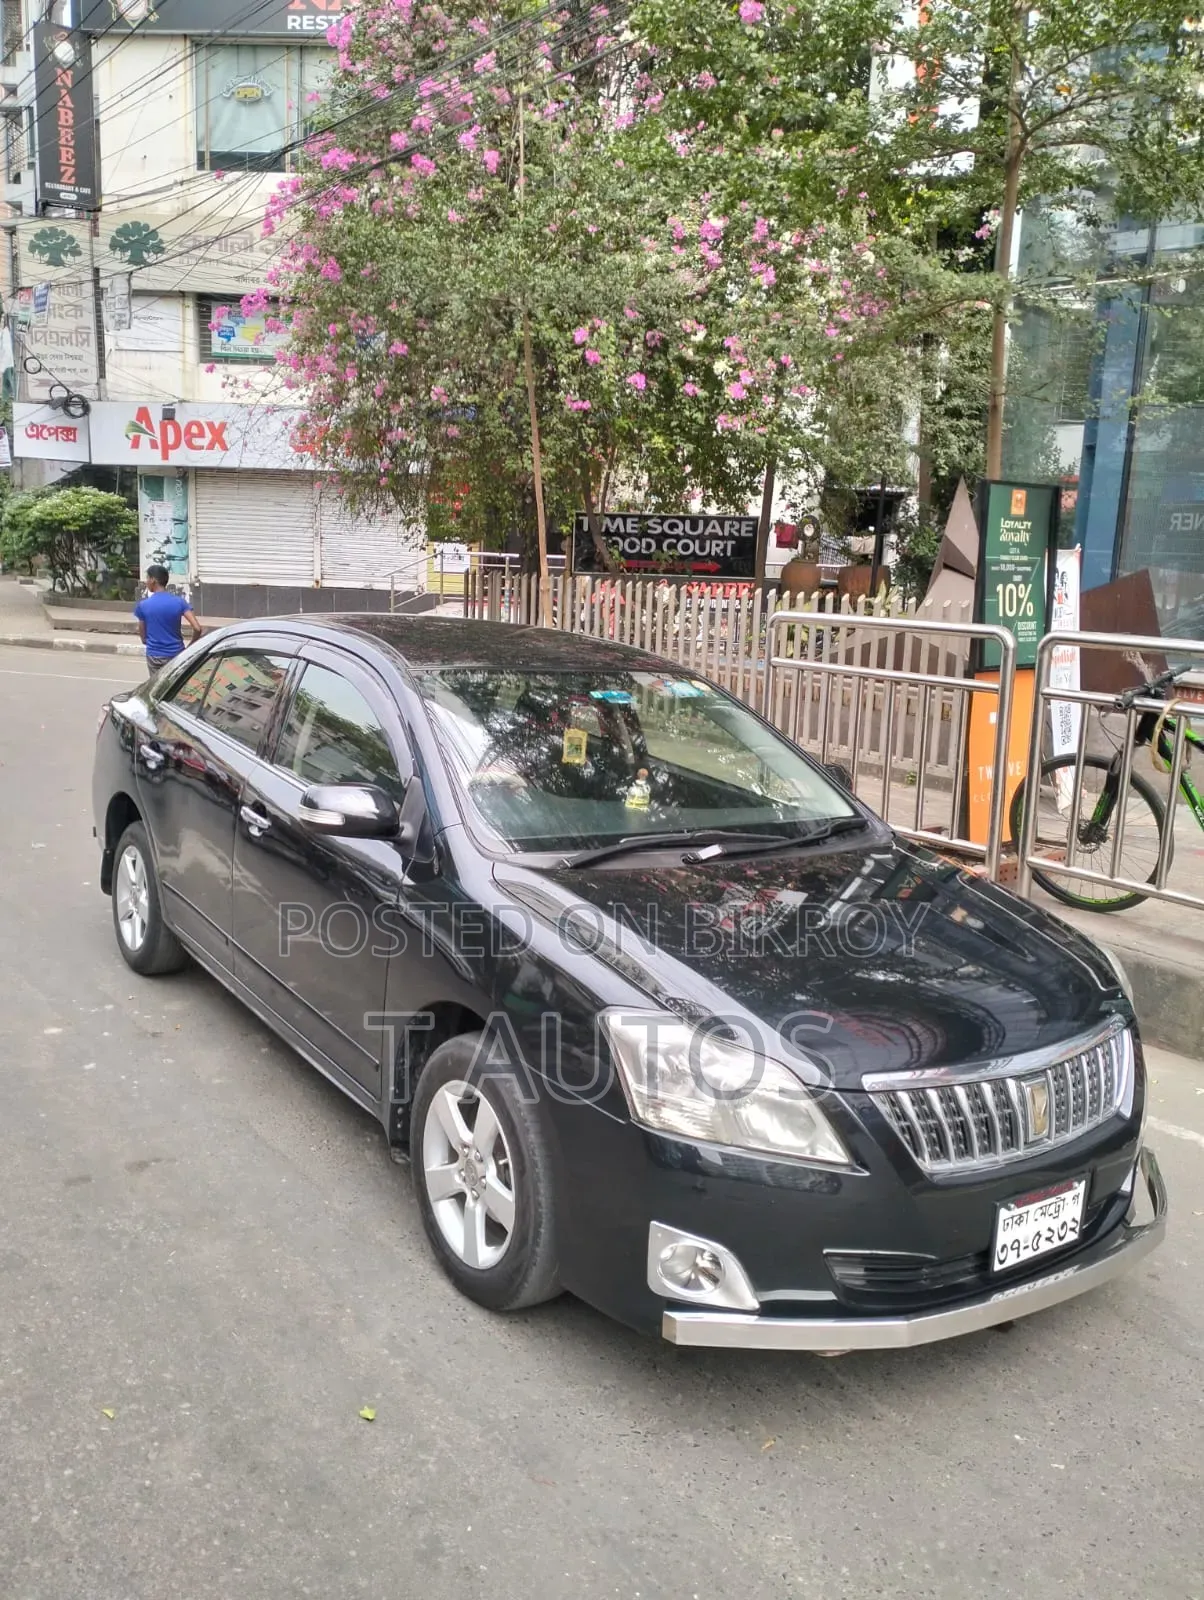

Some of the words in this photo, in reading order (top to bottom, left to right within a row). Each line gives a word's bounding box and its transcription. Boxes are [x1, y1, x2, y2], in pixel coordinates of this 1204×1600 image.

[54, 67, 76, 185] NABEEZ
[25, 421, 78, 443] এপেক্স
[127, 406, 229, 461] Apex
[579, 516, 639, 534] TME
[647, 517, 754, 537] SQUARE
[1000, 517, 1033, 530] LOYALTY
[662, 537, 736, 557] COURT
[996, 583, 1034, 617] 10%
[1003, 1210, 1029, 1232] ঢাকা
[997, 1217, 1079, 1265] ৩৭-৫২৩২
